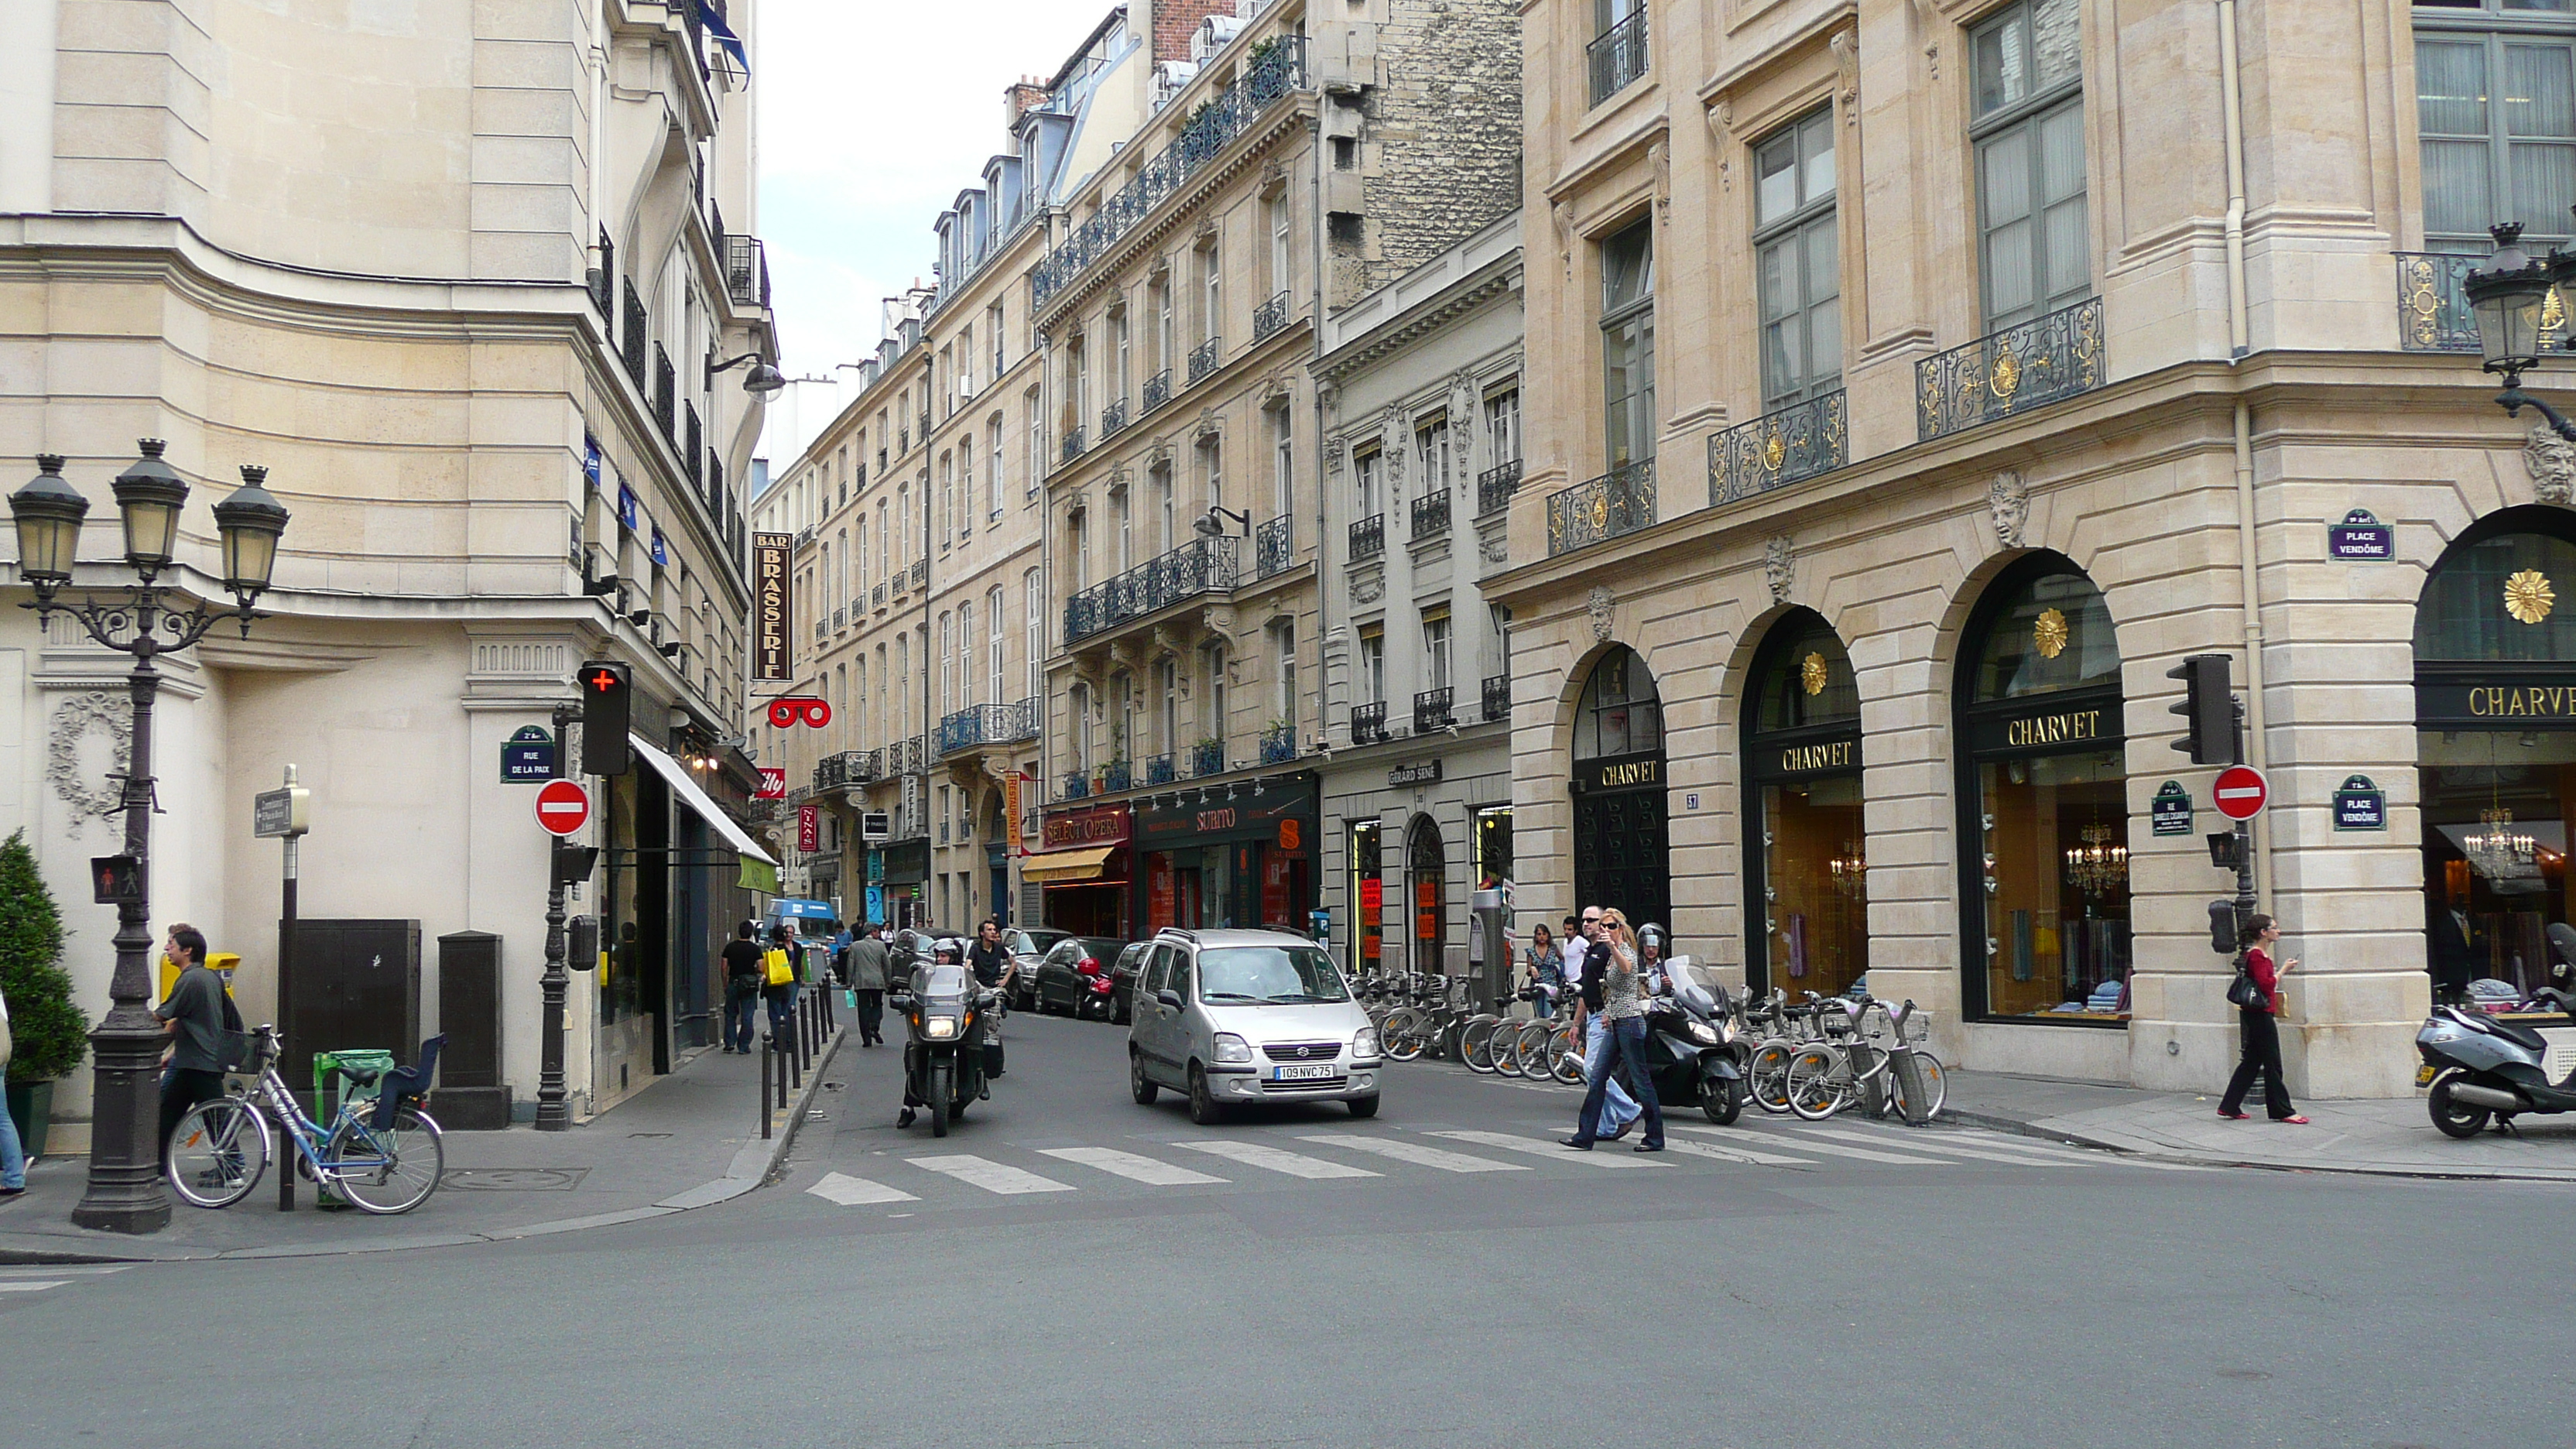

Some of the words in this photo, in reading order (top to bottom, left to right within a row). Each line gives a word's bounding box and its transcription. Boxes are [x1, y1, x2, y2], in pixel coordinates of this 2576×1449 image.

[757, 536, 787, 547] BAR
[2339, 543, 2385, 554] VENDÔME
[2346, 533, 2376, 541] PLACE
[763, 549, 782, 679] BRASSERIE
[2009, 710, 2099, 745] CHARVET
[1783, 742, 1852, 771] CHARVET
[762, 772, 784, 796] lly
[1602, 760, 1656, 786] CHARVET
[1009, 779, 1017, 833] RESTAURANT
[1687, 796, 1697, 807] 37
[2347, 800, 2372, 809] PLACE
[1197, 807, 1236, 831] SUBITO
[2341, 811, 2379, 822] VENDÔME
[1047, 823, 1082, 844] SELECT
[1084, 818, 1119, 839] OPERA
[1283, 1068, 1298, 1077] 109
[1300, 1067, 1317, 1077] NVC
[1319, 1067, 1331, 1077] 75
